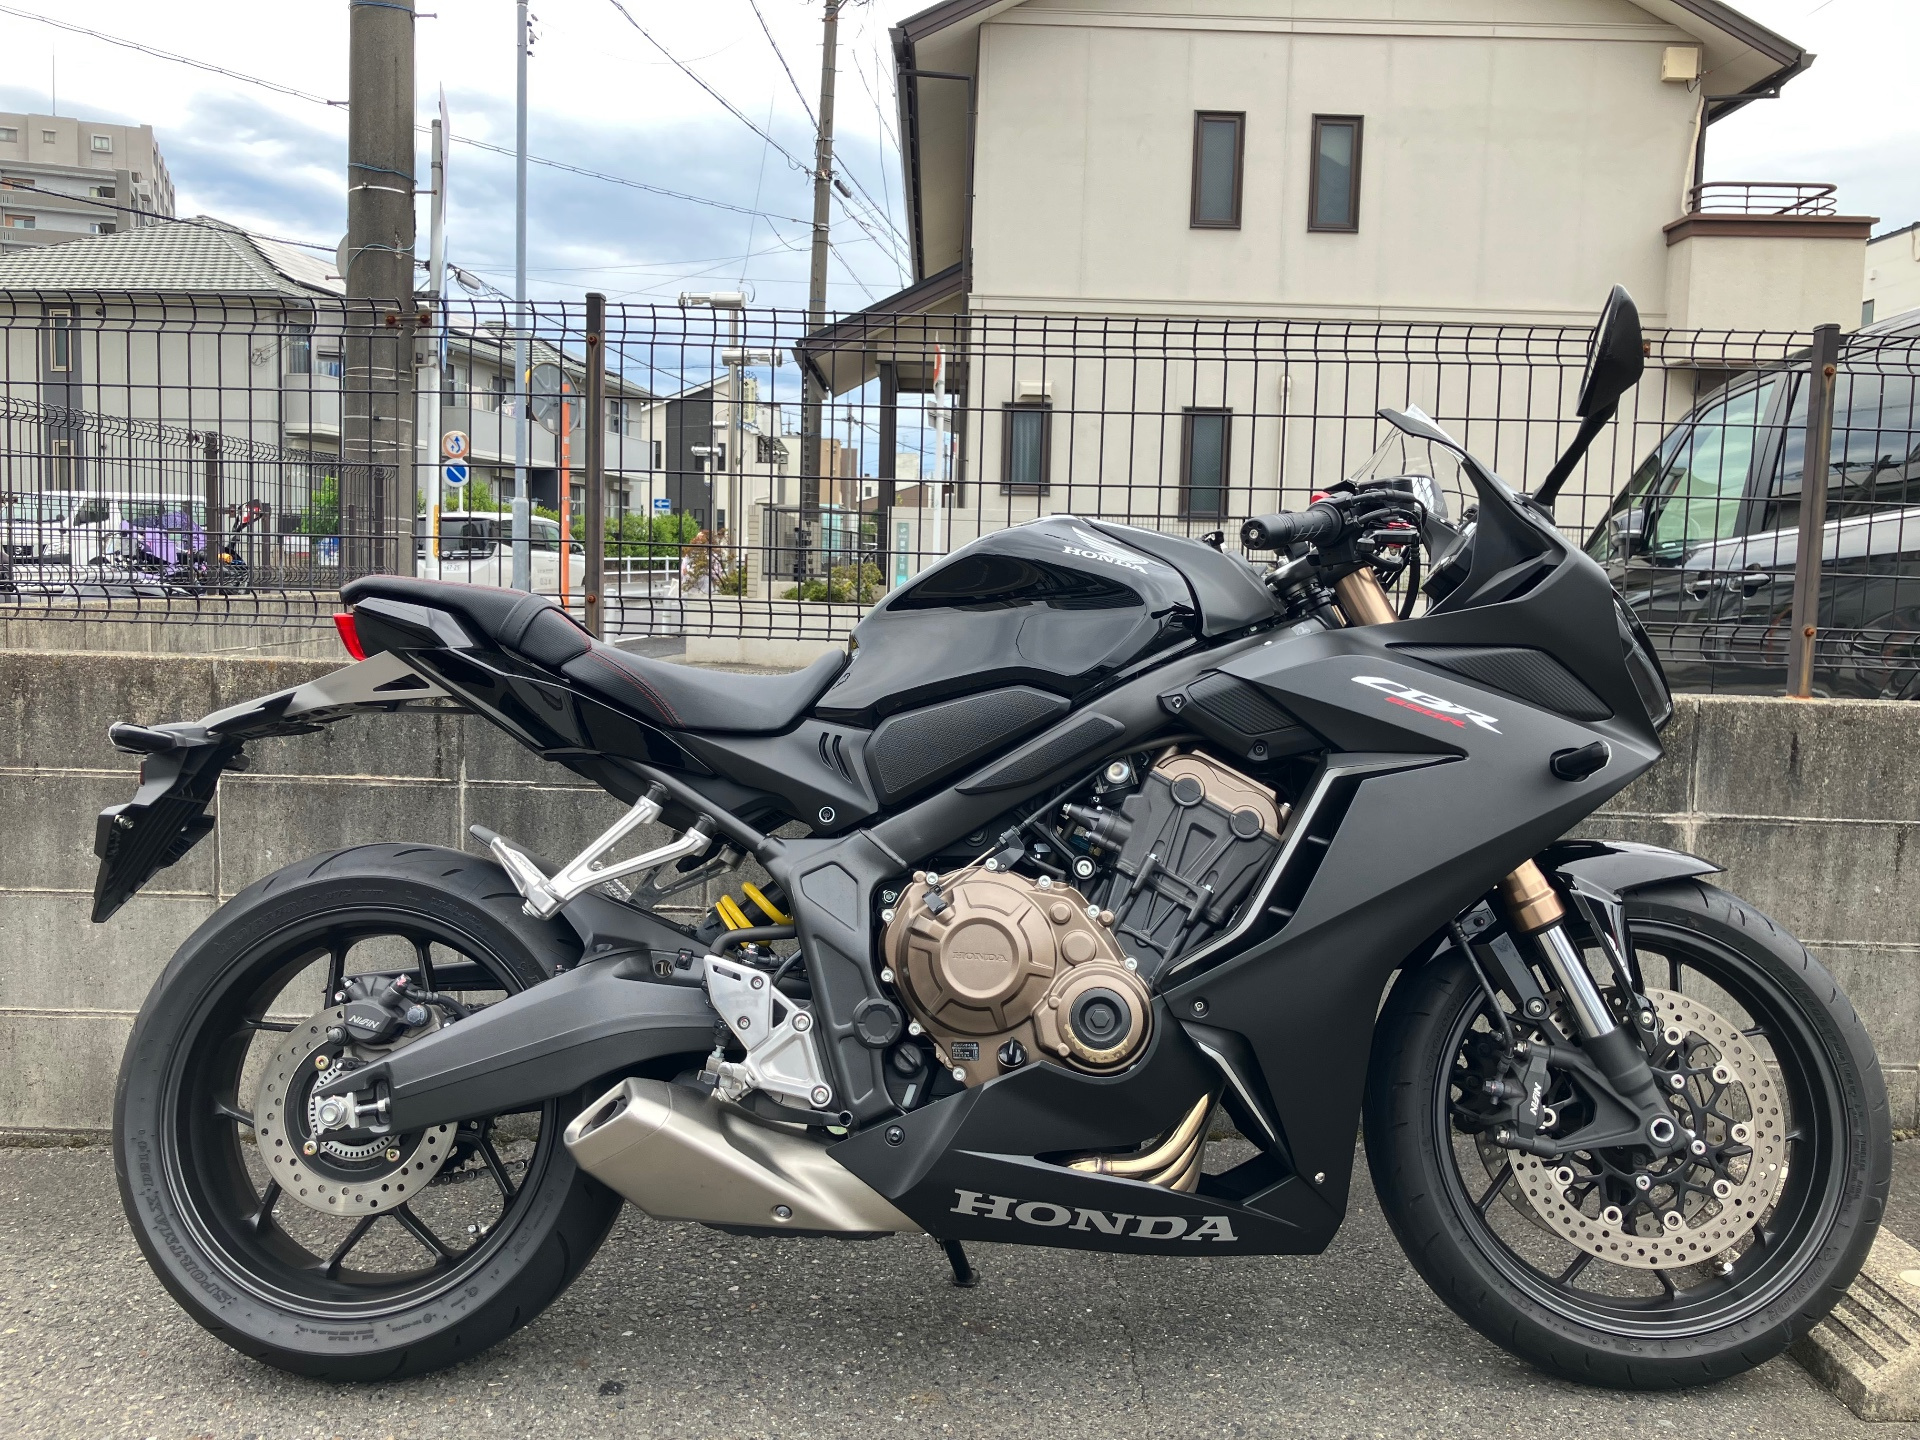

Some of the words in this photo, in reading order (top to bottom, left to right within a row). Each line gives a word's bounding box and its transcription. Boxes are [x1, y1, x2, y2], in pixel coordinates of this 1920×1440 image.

[1062, 545, 1149, 575] HONDA
[1351, 676, 1503, 735] CBR
[1384, 696, 1467, 729] 650R
[952, 951, 1008, 962] HONDA
[348, 1014, 380, 1029] NISSIN
[950, 1189, 1239, 1242] HONDA
[147, 1193, 232, 1303] SPORTMAX
